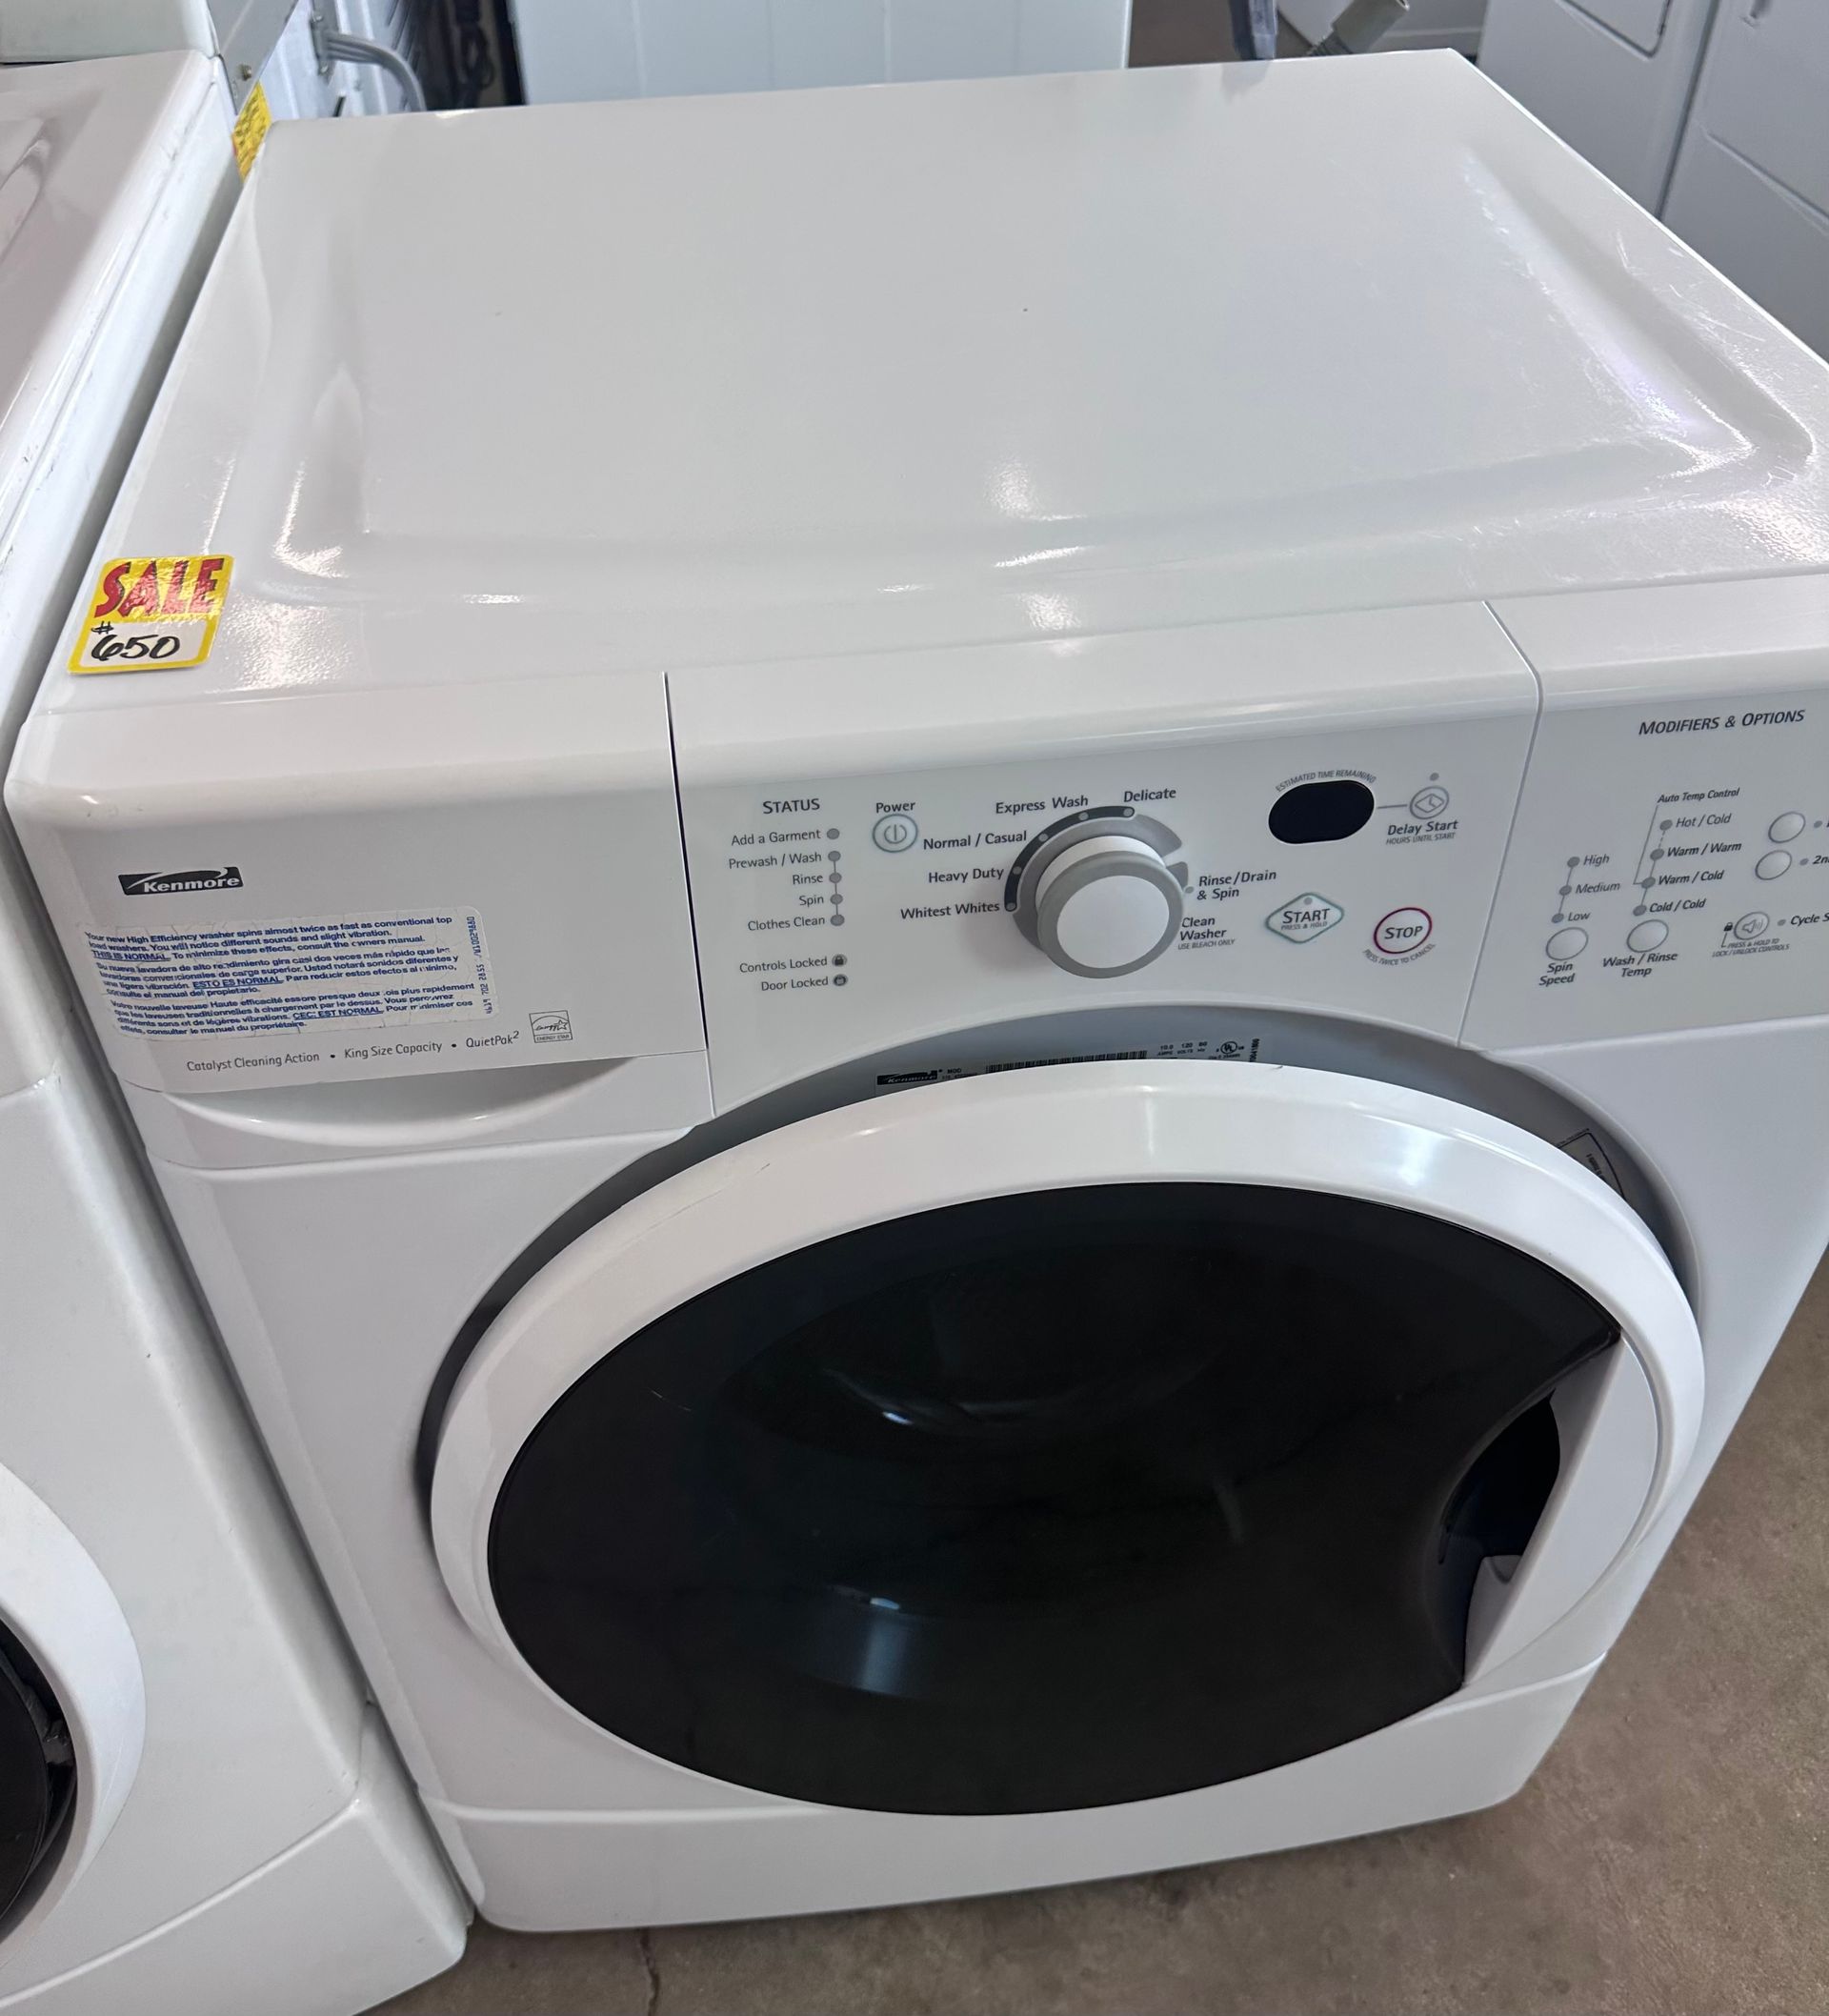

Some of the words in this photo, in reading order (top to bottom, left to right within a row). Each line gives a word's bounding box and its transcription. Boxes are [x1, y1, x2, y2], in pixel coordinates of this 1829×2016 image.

[94, 557, 224, 617] SALE
[1638, 716, 1719, 736] MODIFIERS
[1724, 716, 1736, 728] &
[1741, 710, 1805, 726] OPTIONS
[1275, 772, 1316, 793] ESTIMATED
[1317, 770, 1335, 779] TIME
[1336, 769, 1377, 784] REMAINING
[1123, 788, 1176, 803] Delicate
[1658, 794, 1679, 803] Auto
[1682, 792, 1705, 802] Temp
[1707, 787, 1740, 799] Control
[762, 798, 820, 815] STATUS
[875, 801, 915, 814] Power
[995, 800, 1045, 816] Express
[1052, 795, 1089, 809] Wash
[1388, 823, 1422, 837] Delay
[1425, 819, 1458, 833] Start
[1676, 816, 1697, 828] Hot
[1698, 814, 1706, 827] /
[1706, 813, 1733, 825] Cold
[732, 834, 754, 846] Add
[769, 830, 821, 843] Garment
[923, 835, 971, 850] Normal
[975, 833, 981, 847] /
[985, 831, 1027, 845] Casual
[1386, 835, 1411, 846] HOURS
[1412, 834, 1433, 843] UNTIL
[1434, 832, 1457, 842] START
[1667, 846, 1699, 857] Warm
[1700, 842, 1709, 856] /
[1710, 842, 1742, 854] Warm
[729, 856, 777, 869] Prewash
[781, 854, 786, 867] /
[789, 852, 822, 864] Wash
[1583, 854, 1610, 867] High
[792, 874, 823, 885] Rinse
[928, 872, 968, 883] Heavy
[973, 867, 1004, 879] Duty
[1658, 875, 1690, 885] Warm
[1691, 871, 1699, 884] /
[1700, 869, 1725, 881] Cold
[144, 877, 240, 893] Kenmore
[1575, 882, 1620, 895] Medium
[798, 895, 824, 907] Spin
[1196, 890, 1207, 900] &
[1211, 886, 1239, 901] Spin
[900, 906, 952, 919] Whitest
[955, 902, 1000, 915] Whites
[1649, 900, 1674, 913] Cold
[1674, 899, 1681, 912] /
[1682, 897, 1707, 910] Cold
[1181, 917, 1216, 928] Clean
[1282, 908, 1331, 924] START
[1567, 911, 1591, 921] Low
[1790, 914, 1820, 926] Cycle
[127, 936, 149, 944] High
[151, 934, 197, 942] Efficiency
[198, 931, 234, 939] washer
[237, 929, 263, 938] spins
[265, 926, 298, 936] almost
[374, 917, 434, 928] conventional
[748, 919, 791, 931] Clothes
[794, 917, 826, 927] Clean
[221, 938, 262, 947] different
[320, 932, 346, 940] slight
[348, 930, 392, 938] vibration.
[1179, 929, 1227, 941] Washer
[1384, 925, 1423, 940] STOP
[297, 941, 332, 951] consult
[388, 936, 426, 944] manual.
[304, 963, 332, 972] Usted
[366, 958, 404, 967] sonidos
[405, 956, 452, 965] diferentes
[739, 960, 787, 973] Controls
[790, 956, 828, 969] Locked
[1602, 956, 1635, 967] Wash
[1638, 953, 1646, 965] /
[1646, 952, 1678, 963] Rinse
[311, 971, 344, 979] reducir
[372, 966, 408, 975] efectos
[1547, 961, 1574, 975] Spin
[1621, 967, 1653, 978] Temp
[761, 980, 788, 991] Door
[791, 976, 829, 988] Locked
[1538, 973, 1576, 987] Speed
[318, 993, 356, 1003] presque
[422, 983, 475, 994] rapidement
[187, 1058, 232, 1072] Catalyst
[234, 1055, 282, 1068] Cleaning
[285, 1052, 320, 1063] Action
[344, 1048, 369, 1059] King
[372, 1044, 392, 1057] Size
[395, 1042, 443, 1056] Capacity
